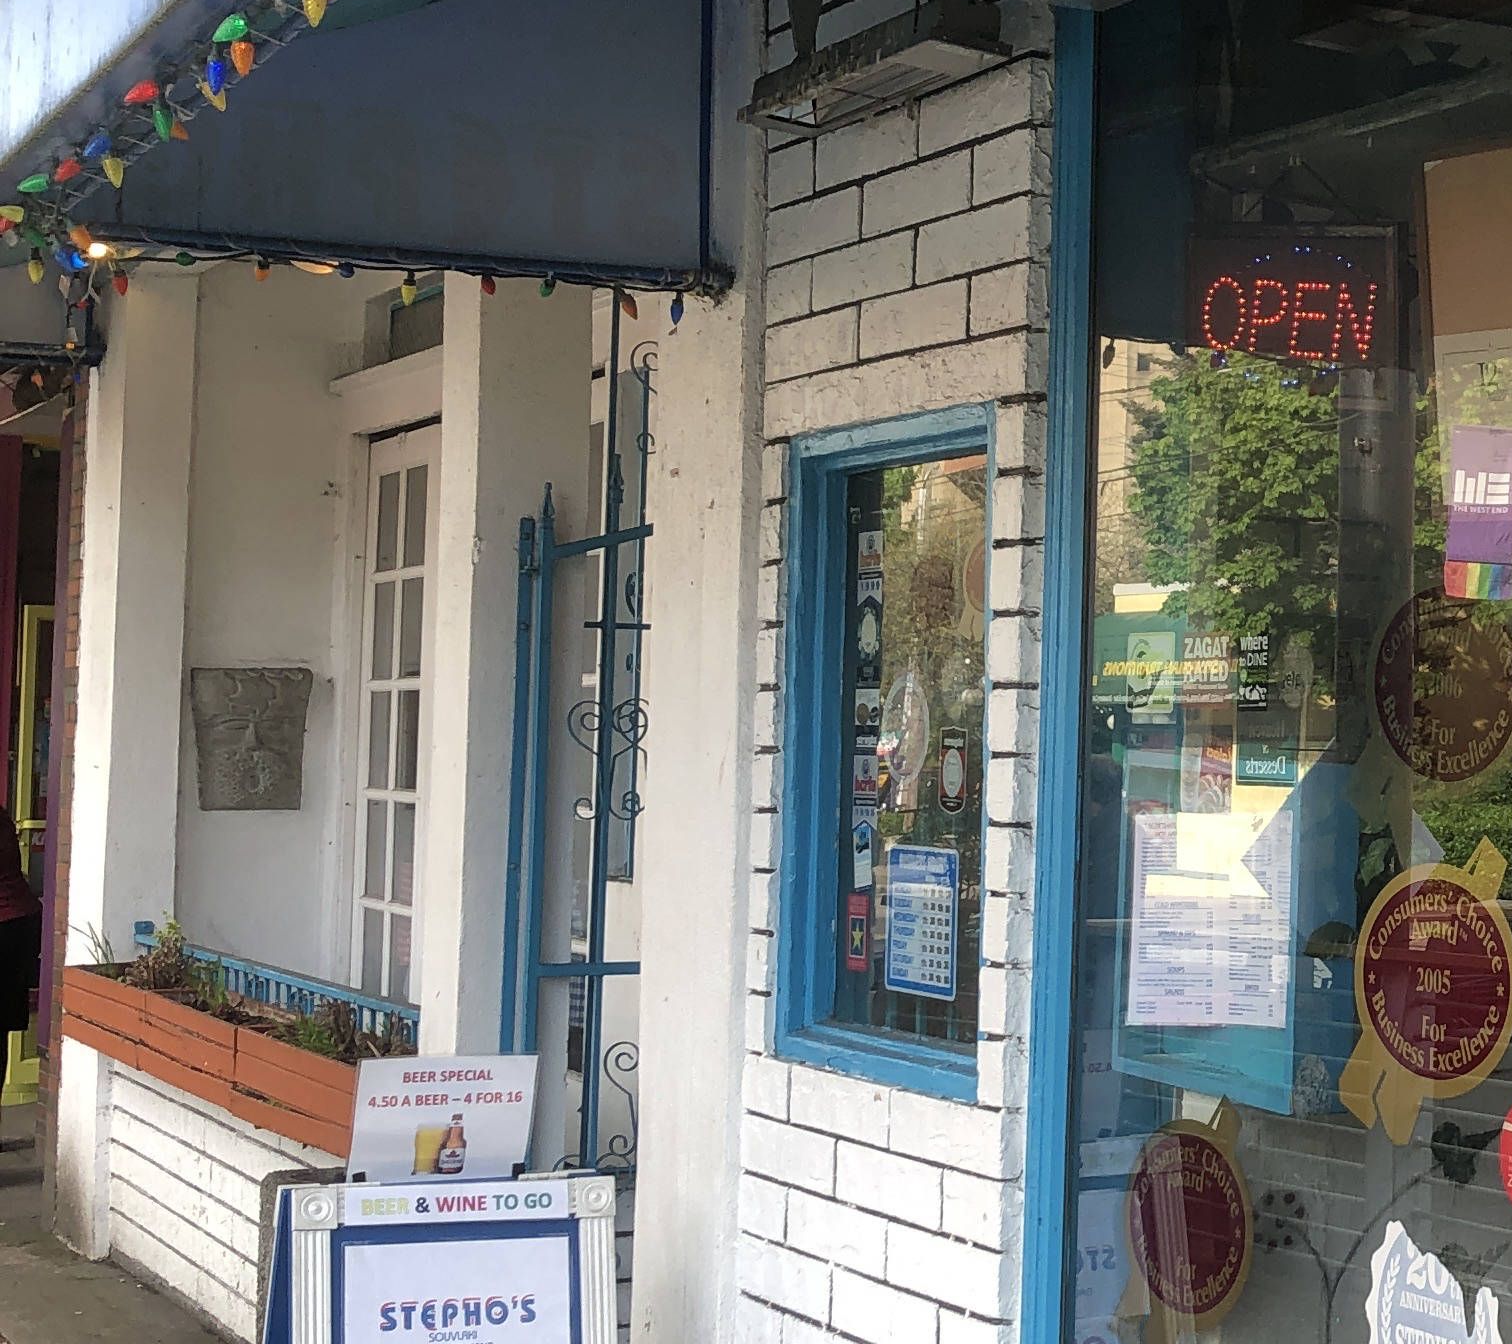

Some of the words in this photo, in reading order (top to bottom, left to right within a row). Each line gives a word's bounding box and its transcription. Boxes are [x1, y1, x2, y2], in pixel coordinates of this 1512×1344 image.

[1201, 275, 1379, 360] OPEN
[1453, 505, 1468, 513] THE
[1491, 506, 1509, 514] END
[1183, 636, 1230, 659] ZAGAT
[1240, 632, 1268, 651] where
[1247, 652, 1268, 666] DINE
[1431, 719, 1456, 745] For
[1438, 709, 1509, 774] Excellence
[1456, 896, 1503, 974] Choice
[1415, 967, 1451, 994] 2005
[1371, 989, 1425, 1069] Business
[1429, 1005, 1500, 1073] Excellence
[1421, 1015, 1447, 1042] For
[402, 1070, 436, 1083] BEER
[440, 1069, 494, 1082] SPECIAL
[368, 1096, 398, 1108] 4.50
[401, 1095, 411, 1107] A
[415, 1094, 449, 1106] BEER
[463, 1093, 472, 1104] 4
[476, 1092, 502, 1104] FOR
[506, 1091, 522, 1103] 16
[1202, 1149, 1240, 1218] Choice
[361, 1198, 410, 1216] BEER
[415, 1197, 430, 1213] &
[435, 1195, 487, 1213] WINE
[492, 1194, 518, 1210] TO
[524, 1193, 552, 1209] GO
[1183, 1246, 1239, 1306] Excellence
[380, 1293, 536, 1332] STEPHO'S
[1400, 1290, 1465, 1325] ANNIVERSAR
[428, 1330, 478, 1343] SOUVLAKI
